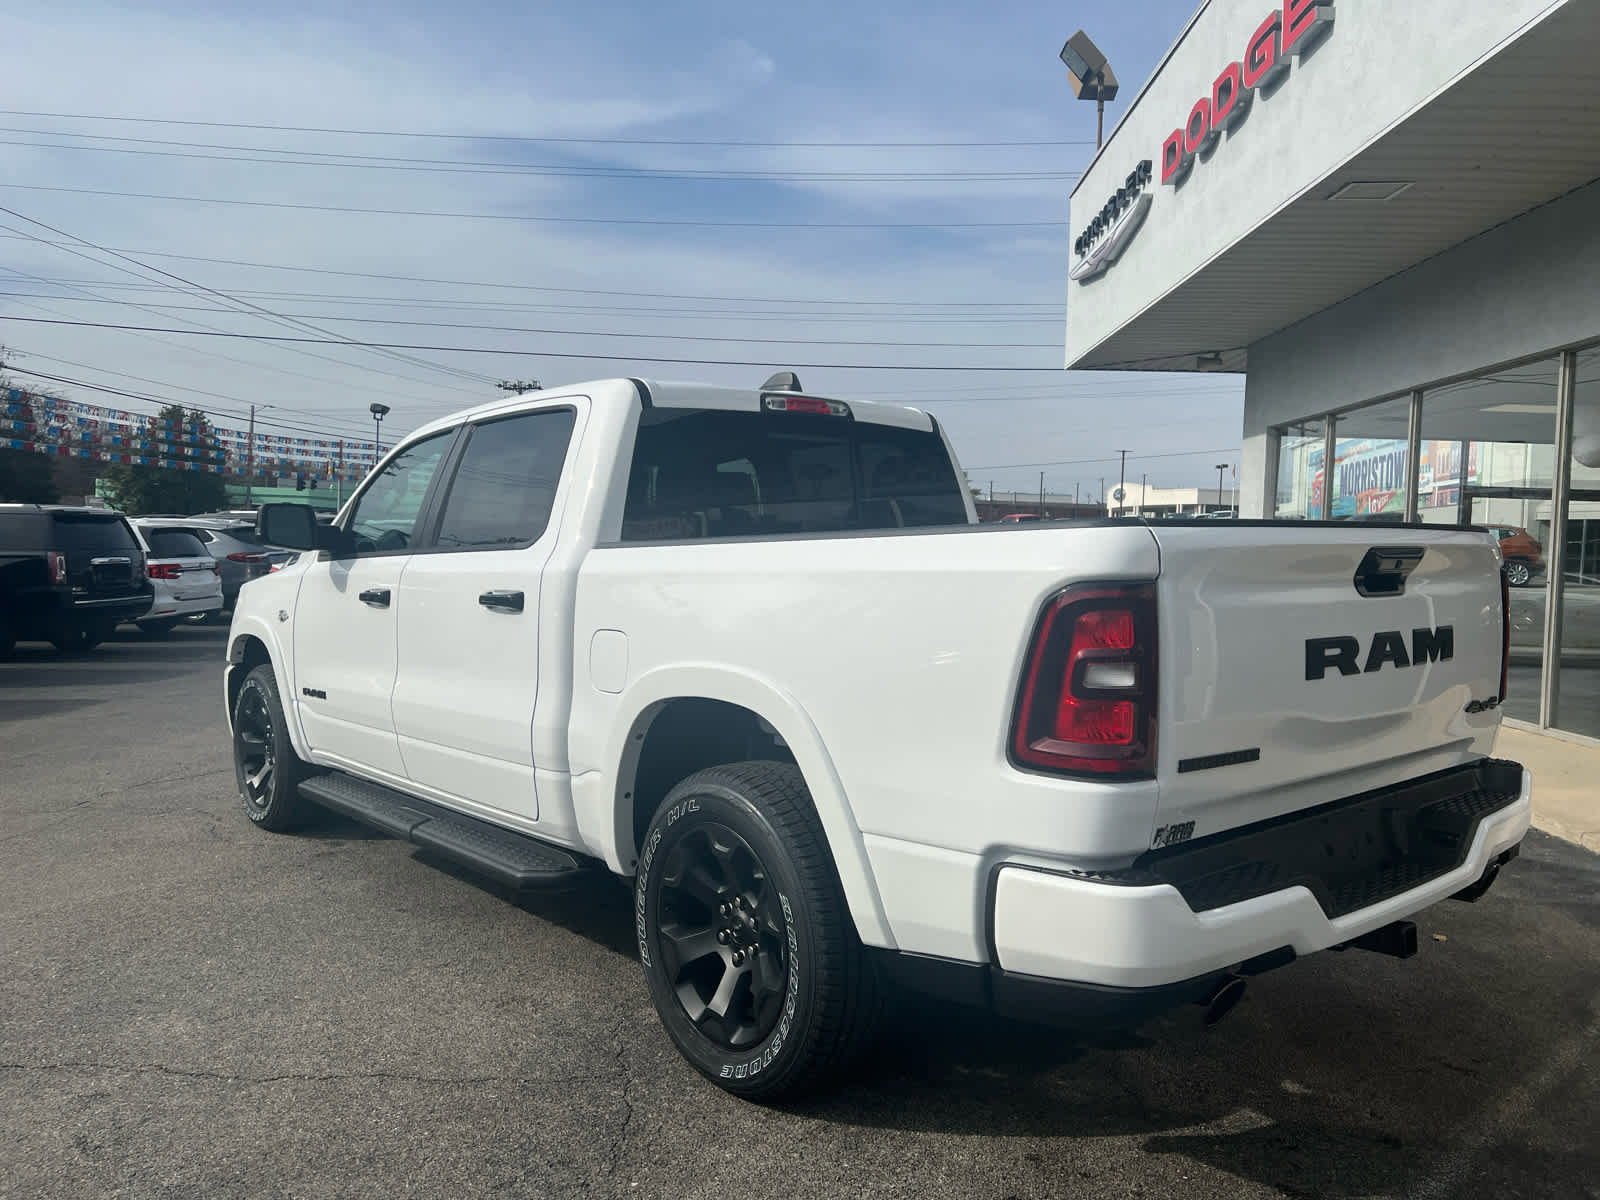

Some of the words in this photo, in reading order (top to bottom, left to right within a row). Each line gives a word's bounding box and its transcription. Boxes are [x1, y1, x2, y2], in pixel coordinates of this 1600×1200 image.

[1161, 0, 1320, 185] DODGE
[1340, 448, 1408, 497] MORRISTOW
[1305, 625, 1454, 681] RAM
[667, 799, 700, 826] H/L
[719, 891, 799, 1078] BRIDGESTONE
